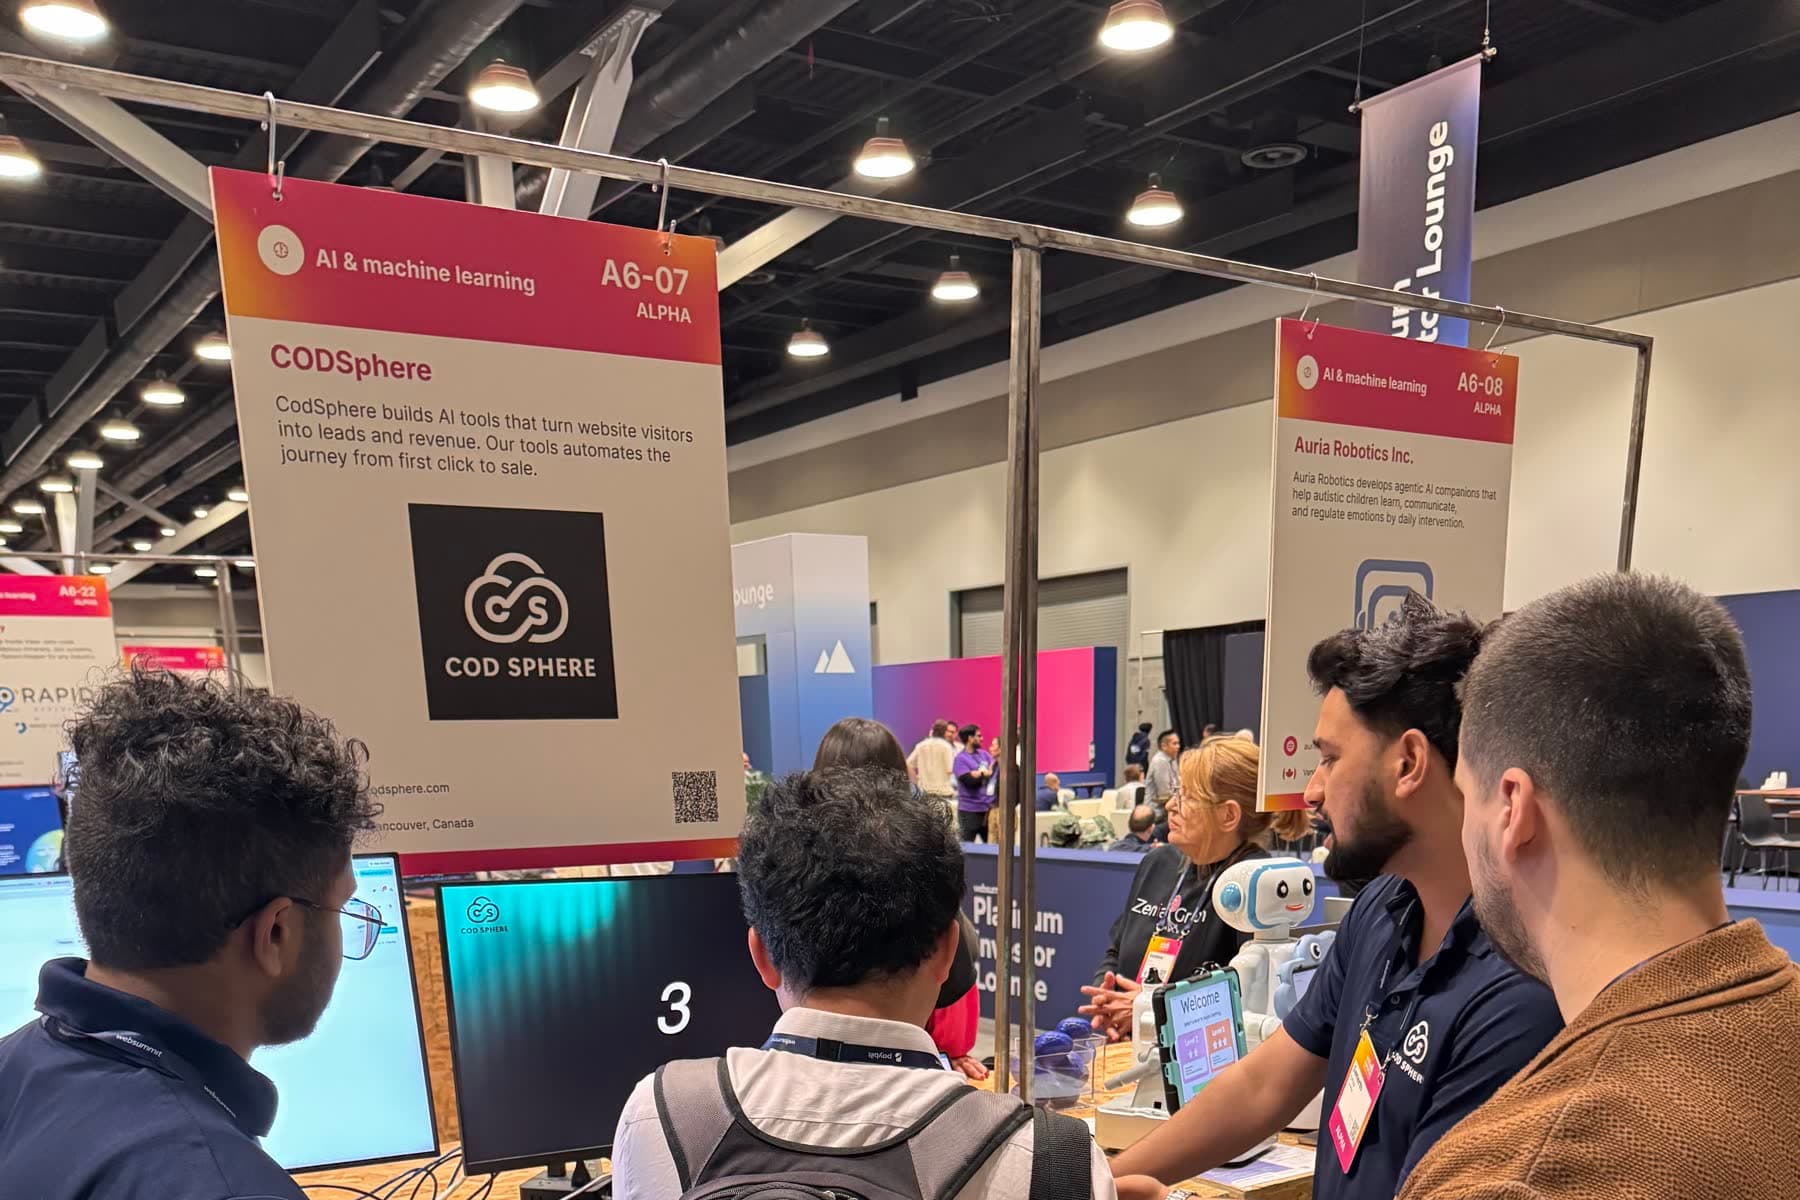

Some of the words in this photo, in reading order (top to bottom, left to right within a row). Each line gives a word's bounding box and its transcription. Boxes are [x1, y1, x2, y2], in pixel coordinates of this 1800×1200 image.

[1415, 120, 1455, 278] Lounge
[316, 249, 338, 269] AI
[343, 252, 358, 272] &
[363, 258, 451, 282] machine
[456, 265, 536, 297] learning
[601, 258, 689, 296] A6-07
[637, 302, 691, 324] ALPHA
[271, 344, 432, 381] CODSphere
[1323, 367, 1334, 381] AI
[1336, 368, 1344, 382] &
[1345, 372, 1387, 389] machine
[1388, 376, 1427, 397] learning
[1457, 372, 1504, 397] A6-08
[275, 395, 377, 419] CodSphere
[382, 404, 433, 423] builds
[439, 409, 455, 424] AI
[460, 411, 500, 428] tools
[504, 413, 537, 431] that
[542, 417, 573, 433] turn
[578, 421, 637, 438] website
[641, 425, 694, 443] visitors
[1473, 401, 1502, 416] ALPHA
[278, 420, 313, 438] into
[318, 423, 366, 442] leads
[371, 429, 403, 444] and
[408, 432, 481, 450] revenue.
[486, 435, 515, 452] Our
[520, 438, 559, 455] tools
[563, 443, 643, 461] automates
[647, 447, 671, 463] the
[1294, 435, 1330, 456] Auria
[1333, 440, 1389, 462] Robotics
[1392, 446, 1414, 465] Inc.
[280, 444, 347, 469] journey
[352, 449, 394, 468] from
[399, 452, 432, 470] first
[437, 455, 476, 473] click
[479, 459, 496, 474] to
[501, 460, 538, 476] sale.
[1292, 488, 1311, 503] help
[1313, 490, 1344, 504] autistic
[1346, 492, 1379, 506] children
[1380, 495, 1402, 510] learn,
[1404, 499, 1457, 514] communicate,
[1293, 471, 1316, 484] Auria
[1318, 473, 1354, 487] Robotics
[1356, 478, 1393, 493] develops
[1395, 481, 1424, 495] agentic
[1425, 483, 1434, 494] AI
[1435, 486, 1480, 499] companions
[1482, 489, 1497, 501] that
[1292, 507, 1308, 517] and
[1311, 507, 1345, 521] regulate
[1347, 510, 1384, 523] emotions
[1386, 513, 1396, 525] by
[1398, 513, 1416, 527] daily
[1418, 515, 1465, 529] intervention.
[734, 583, 775, 609] ounge
[445, 656, 500, 678] COD
[507, 656, 597, 678] SPHERE
[369, 784, 450, 798] odsphere.com
[432, 818, 474, 829] Canada
[657, 980, 693, 1035] 3
[1180, 991, 1220, 1014] Welcome
